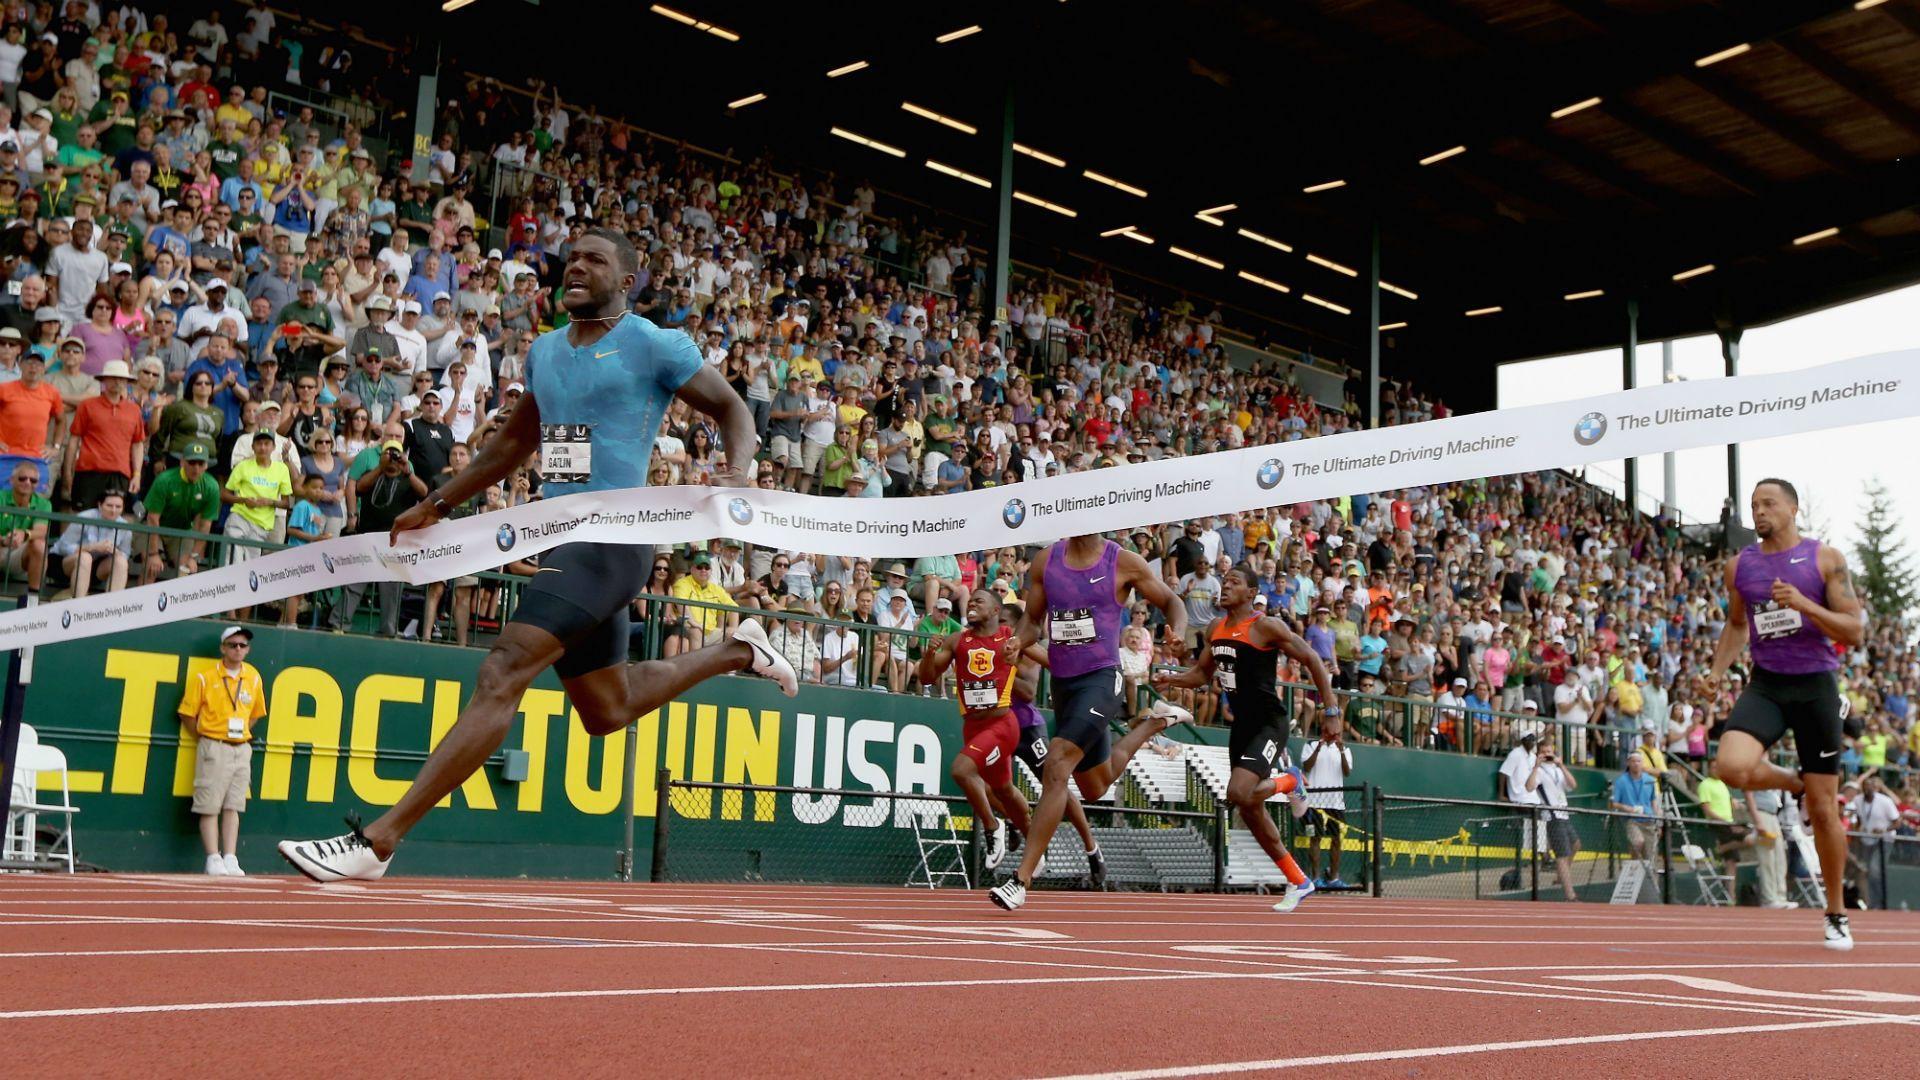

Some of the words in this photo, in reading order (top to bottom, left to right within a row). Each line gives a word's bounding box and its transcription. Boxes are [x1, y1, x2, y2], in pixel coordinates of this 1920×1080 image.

[1617, 414, 1650, 431] The
[1655, 403, 1733, 425] Ultimate
[1739, 394, 1806, 415] Driving
[1292, 462, 1320, 477] The
[1323, 453, 1385, 473] Ultimate
[1389, 444, 1443, 464] Driving
[1031, 503, 1052, 517] The
[1055, 494, 1106, 512] Ultimate
[1108, 487, 1152, 505] Driving
[521, 526, 540, 541] The
[589, 513, 635, 527] Driving
[761, 510, 788, 527] The
[792, 515, 852, 533] Ultimate
[856, 520, 908, 537] Driving
[170, 595, 179, 605] The
[179, 592, 199, 603] Ultimate
[199, 588, 217, 600] Driving
[216, 583, 237, 596] Machine
[73, 613, 83, 623] The
[83, 609, 104, 621] Ultimate
[104, 606, 122, 619] Driving
[122, 603, 144, 616] Machine
[1034, 741, 1044, 755] 8
[1266, 744, 1275, 759] 6
[791, 712, 942, 830] USA
